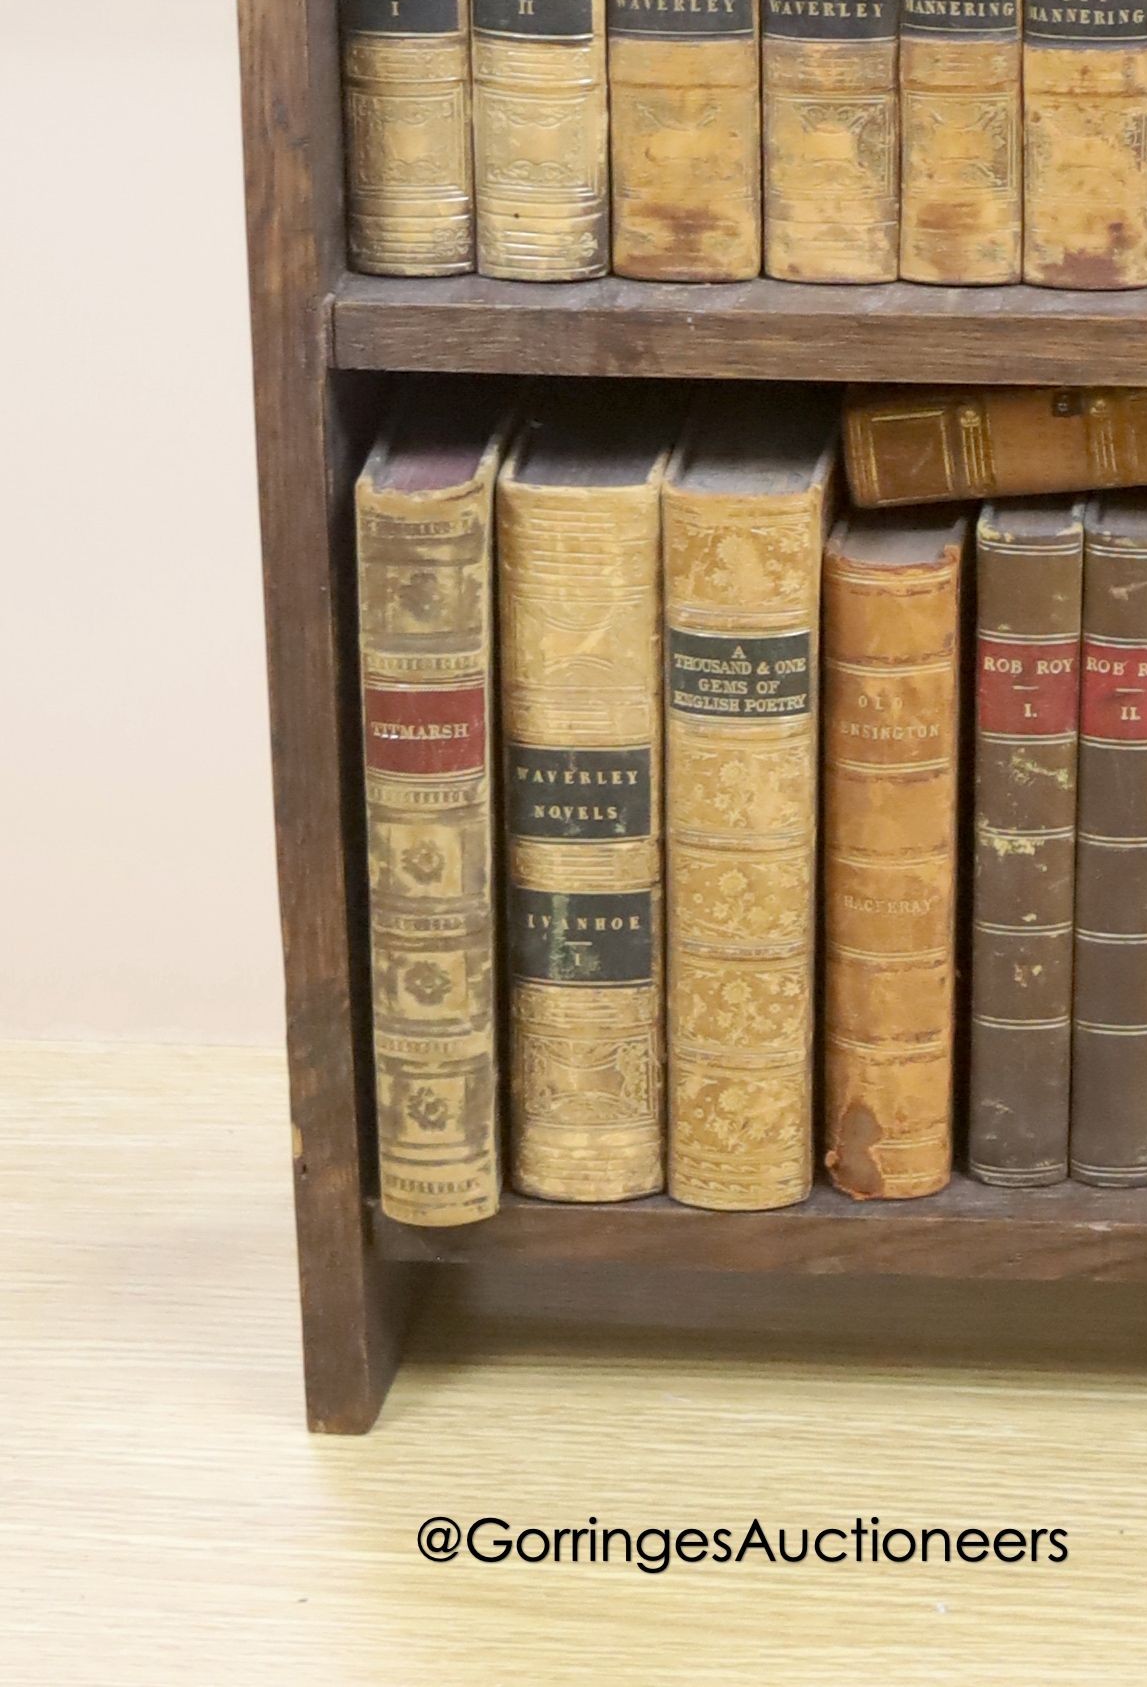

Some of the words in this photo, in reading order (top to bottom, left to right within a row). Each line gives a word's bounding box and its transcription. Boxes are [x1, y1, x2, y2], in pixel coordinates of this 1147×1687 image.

[391, 1, 400, 16] I
[518, 0, 534, 16] II
[1029, 5, 1145, 25] MANNERING
[731, 644, 747, 659] A
[674, 654, 752, 675] THOUSAND
[756, 662, 771, 676] &
[775, 657, 806, 673] ONE
[983, 656, 1023, 675] ROB
[1036, 658, 1074, 675] ROY
[1086, 657, 1126, 676] ROB
[698, 678, 748, 694] GEMS
[757, 680, 780, 694] OF
[673, 693, 740, 712] ENGLISH
[744, 694, 807, 712] POETRY
[1023, 703, 1038, 719] I.
[371, 720, 469, 739] TITMARSH
[517, 768, 639, 786] WAVERLEY
[534, 804, 618, 821] NOVELS
[527, 914, 641, 931] IVANHOE
